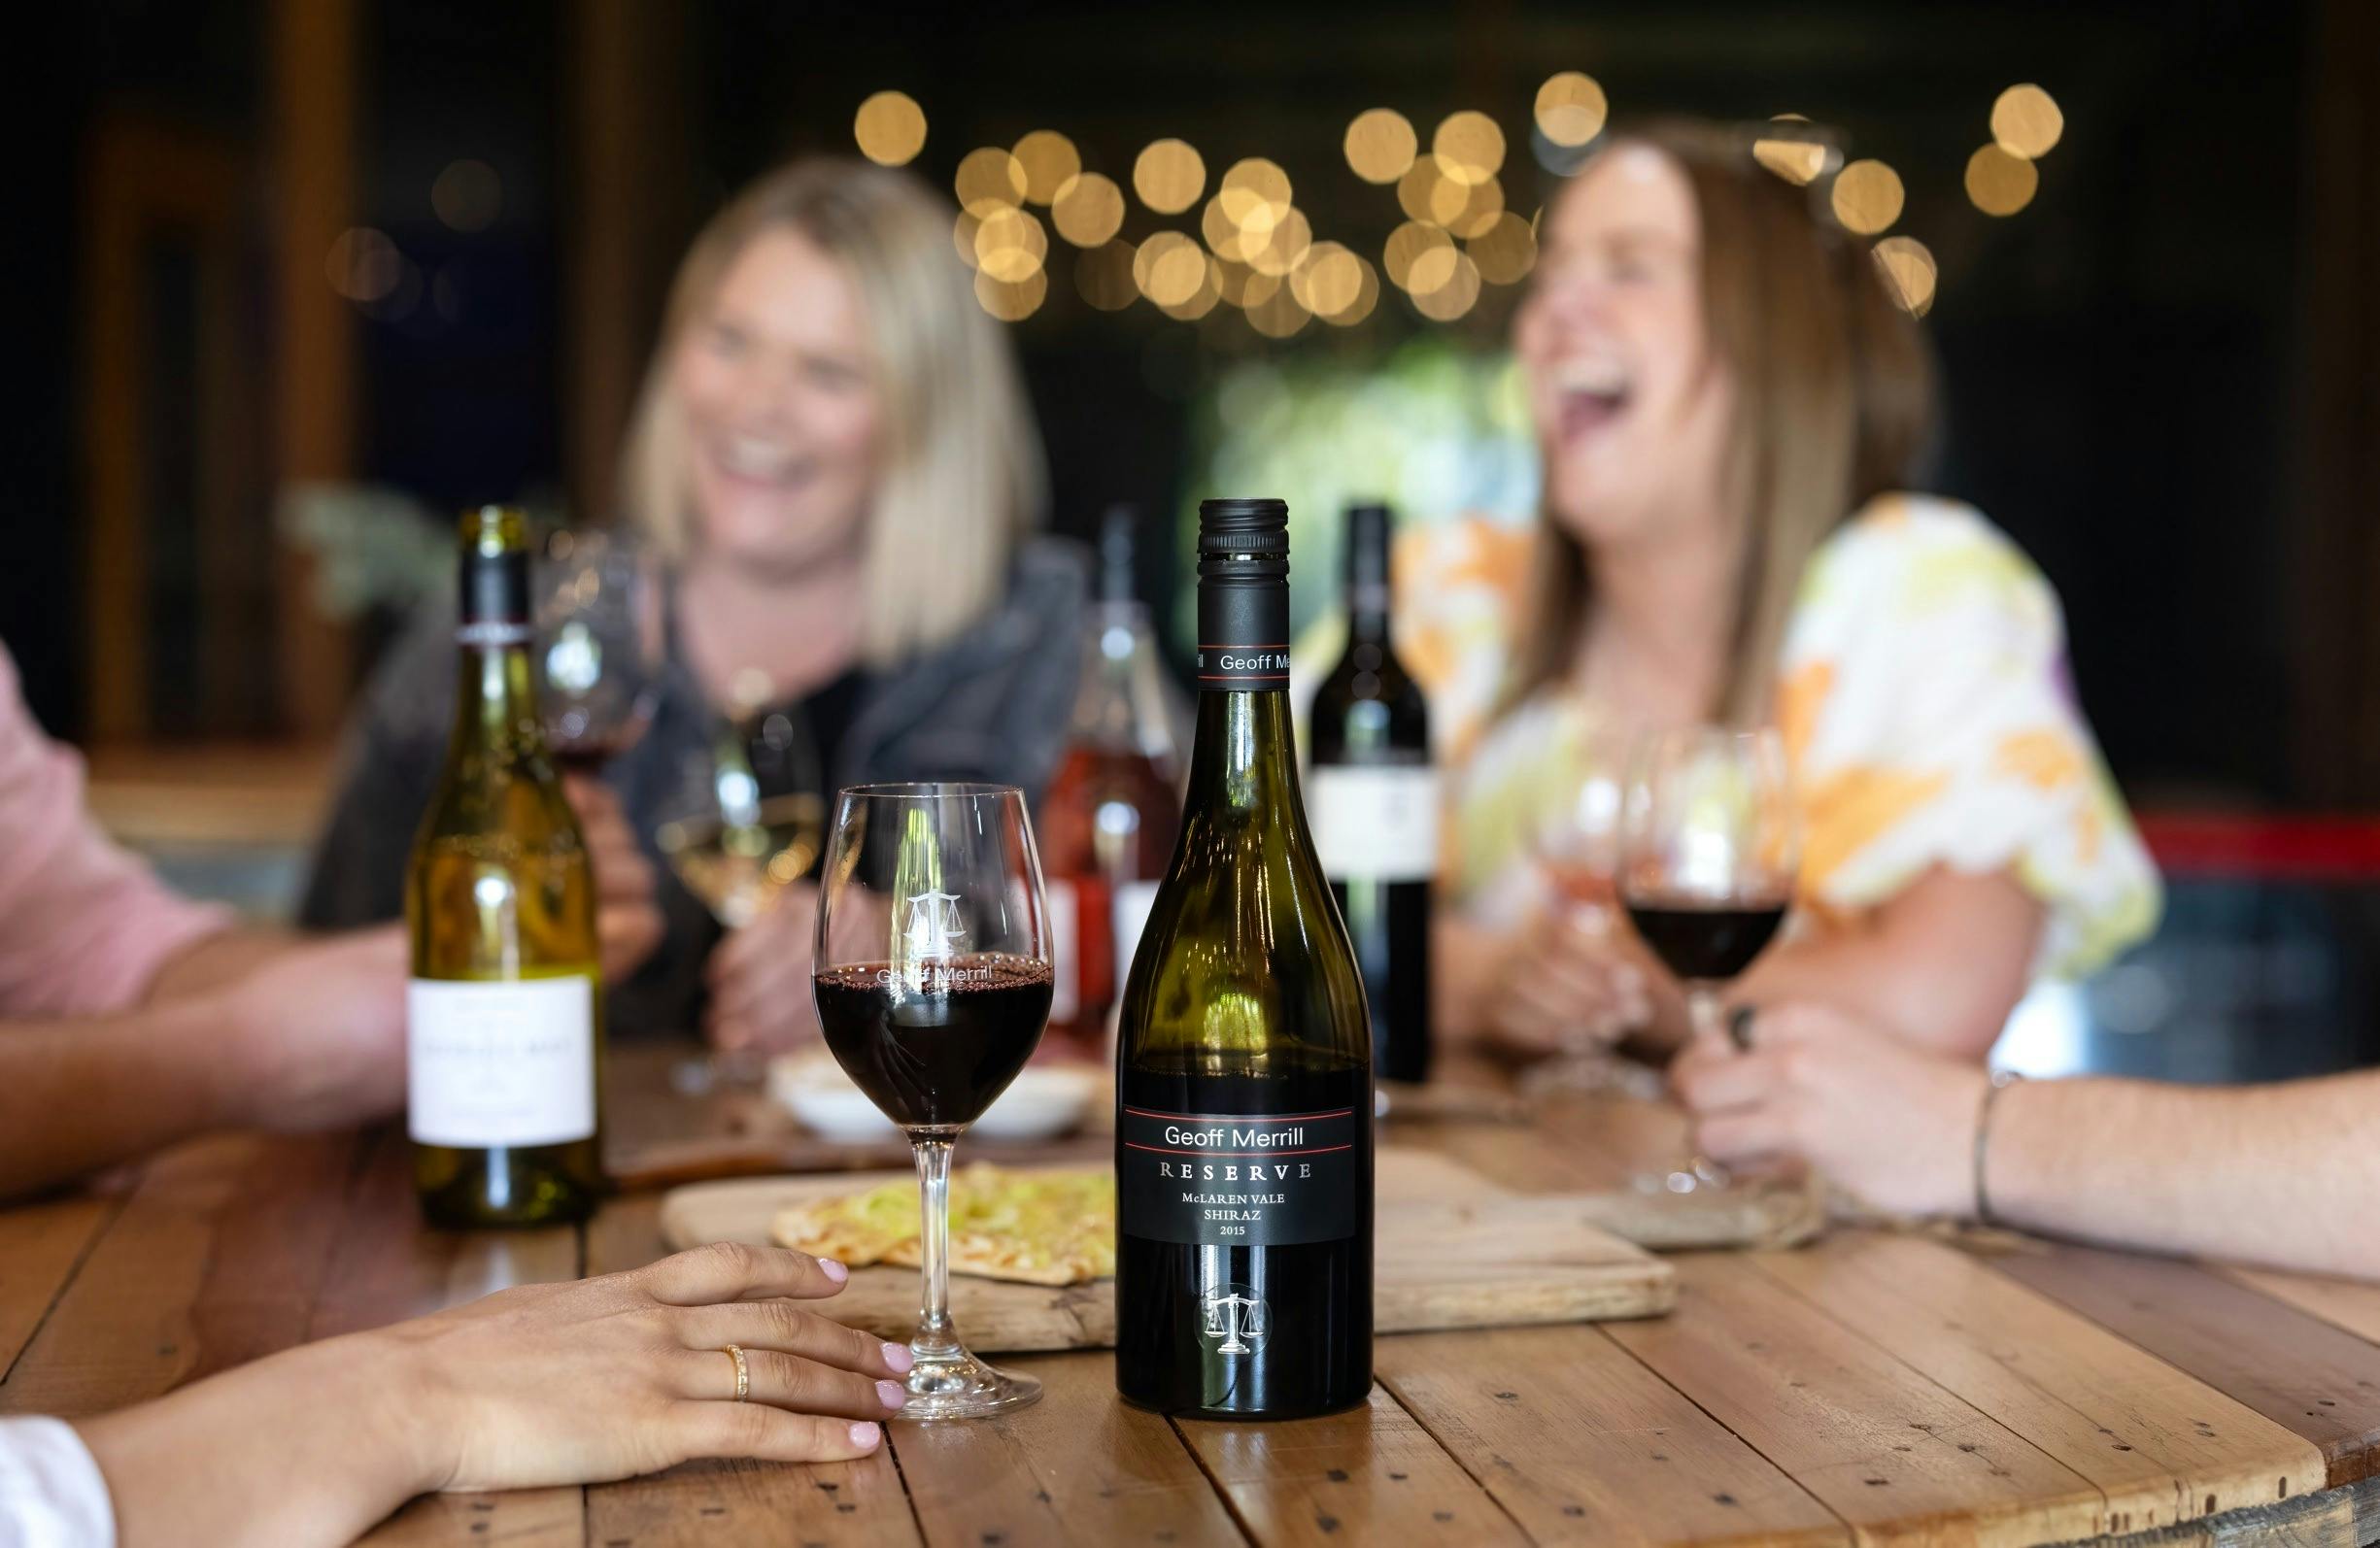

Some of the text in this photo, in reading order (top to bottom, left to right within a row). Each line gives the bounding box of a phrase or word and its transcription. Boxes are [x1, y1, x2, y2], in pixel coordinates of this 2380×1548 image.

[1220, 655, 1271, 670] Geoff
[876, 965, 993, 984] Gef Merrill
[1165, 1126, 1304, 1147] Geoff Merrill
[1160, 1161, 1310, 1181] RESERVE
[1182, 1193, 1285, 1204] McLAREN VALE
[1204, 1209, 1261, 1221] SHIRAZ
[1219, 1226, 1245, 1236] 2015
